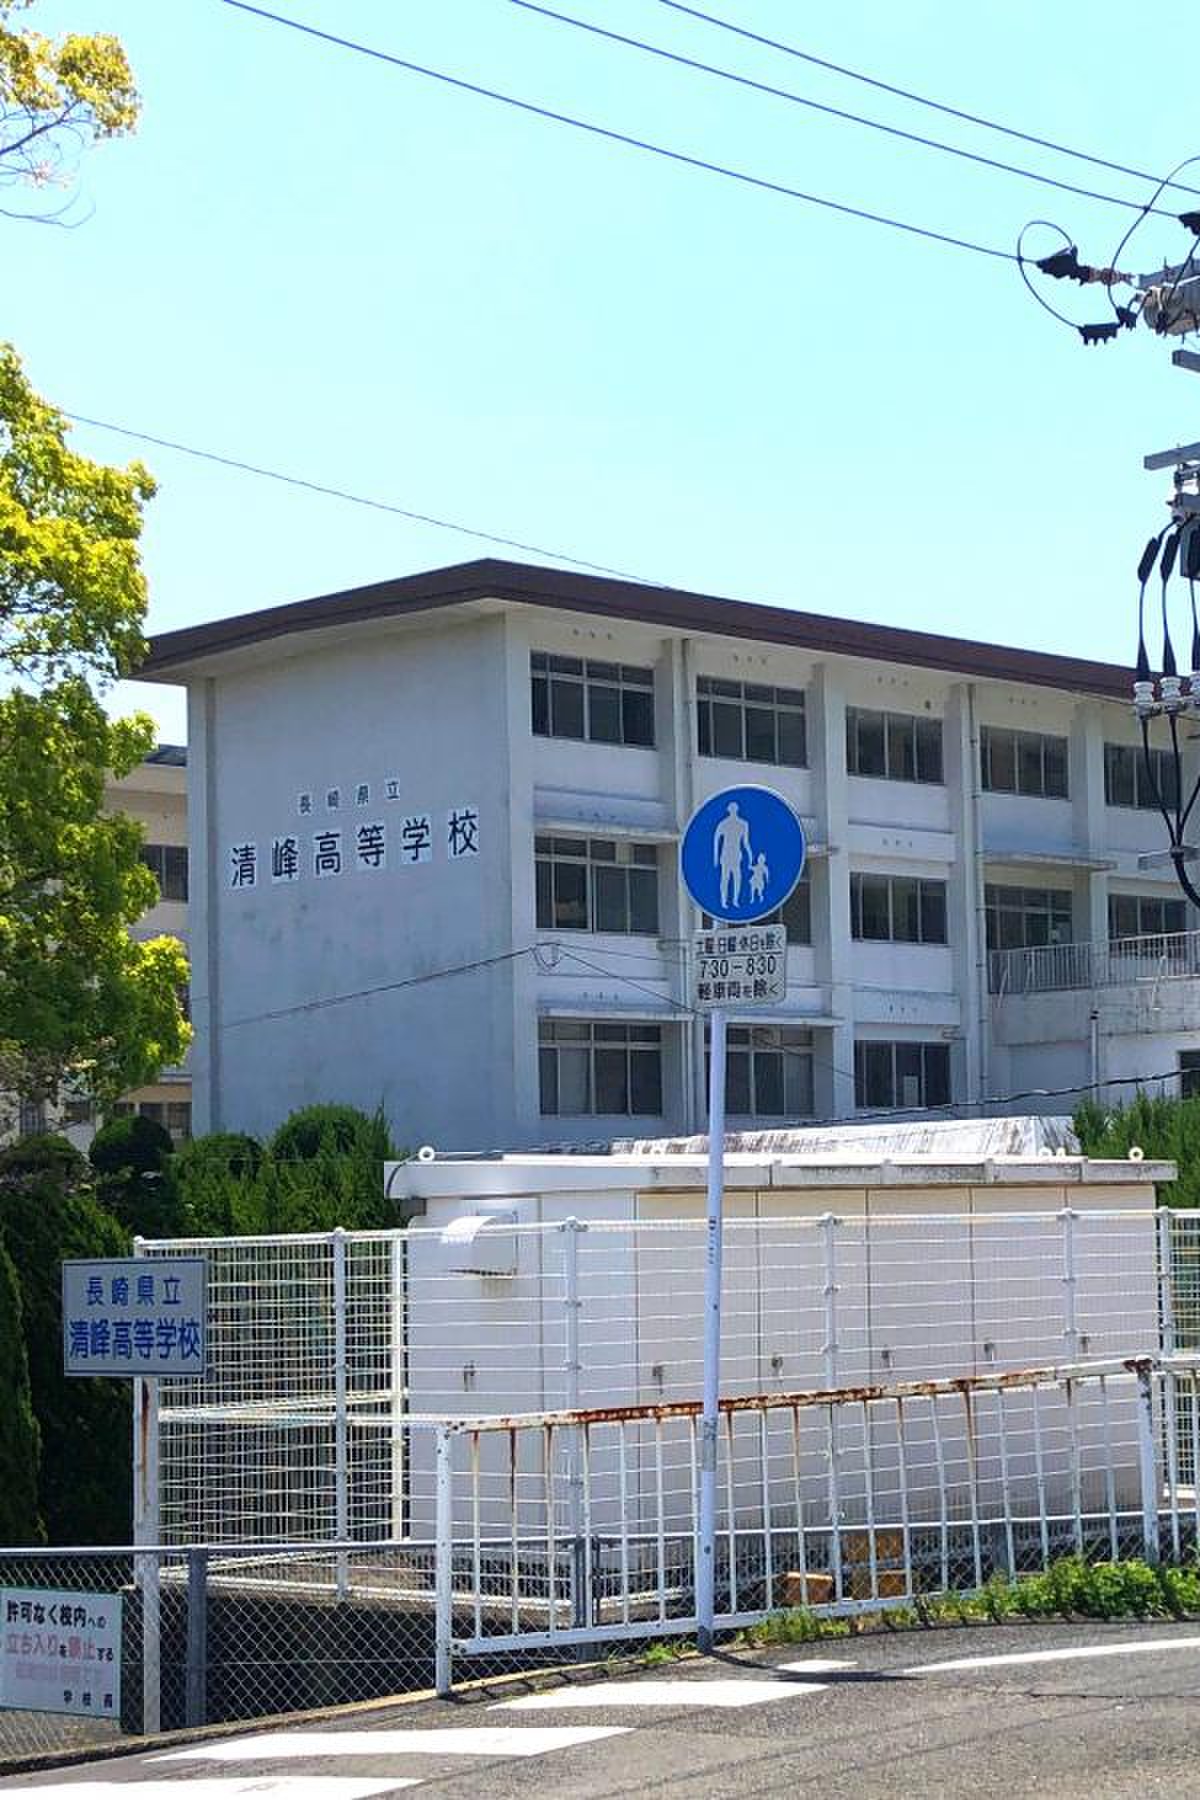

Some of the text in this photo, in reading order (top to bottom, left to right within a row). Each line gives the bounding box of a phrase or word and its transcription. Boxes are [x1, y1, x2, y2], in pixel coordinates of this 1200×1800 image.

[299, 779, 401, 815] 長崎県立
[230, 810, 479, 887] 清峰高等学校
[86, 1275, 182, 1306] 長崎県立
[69, 1317, 201, 1360] 清峰高等学校
